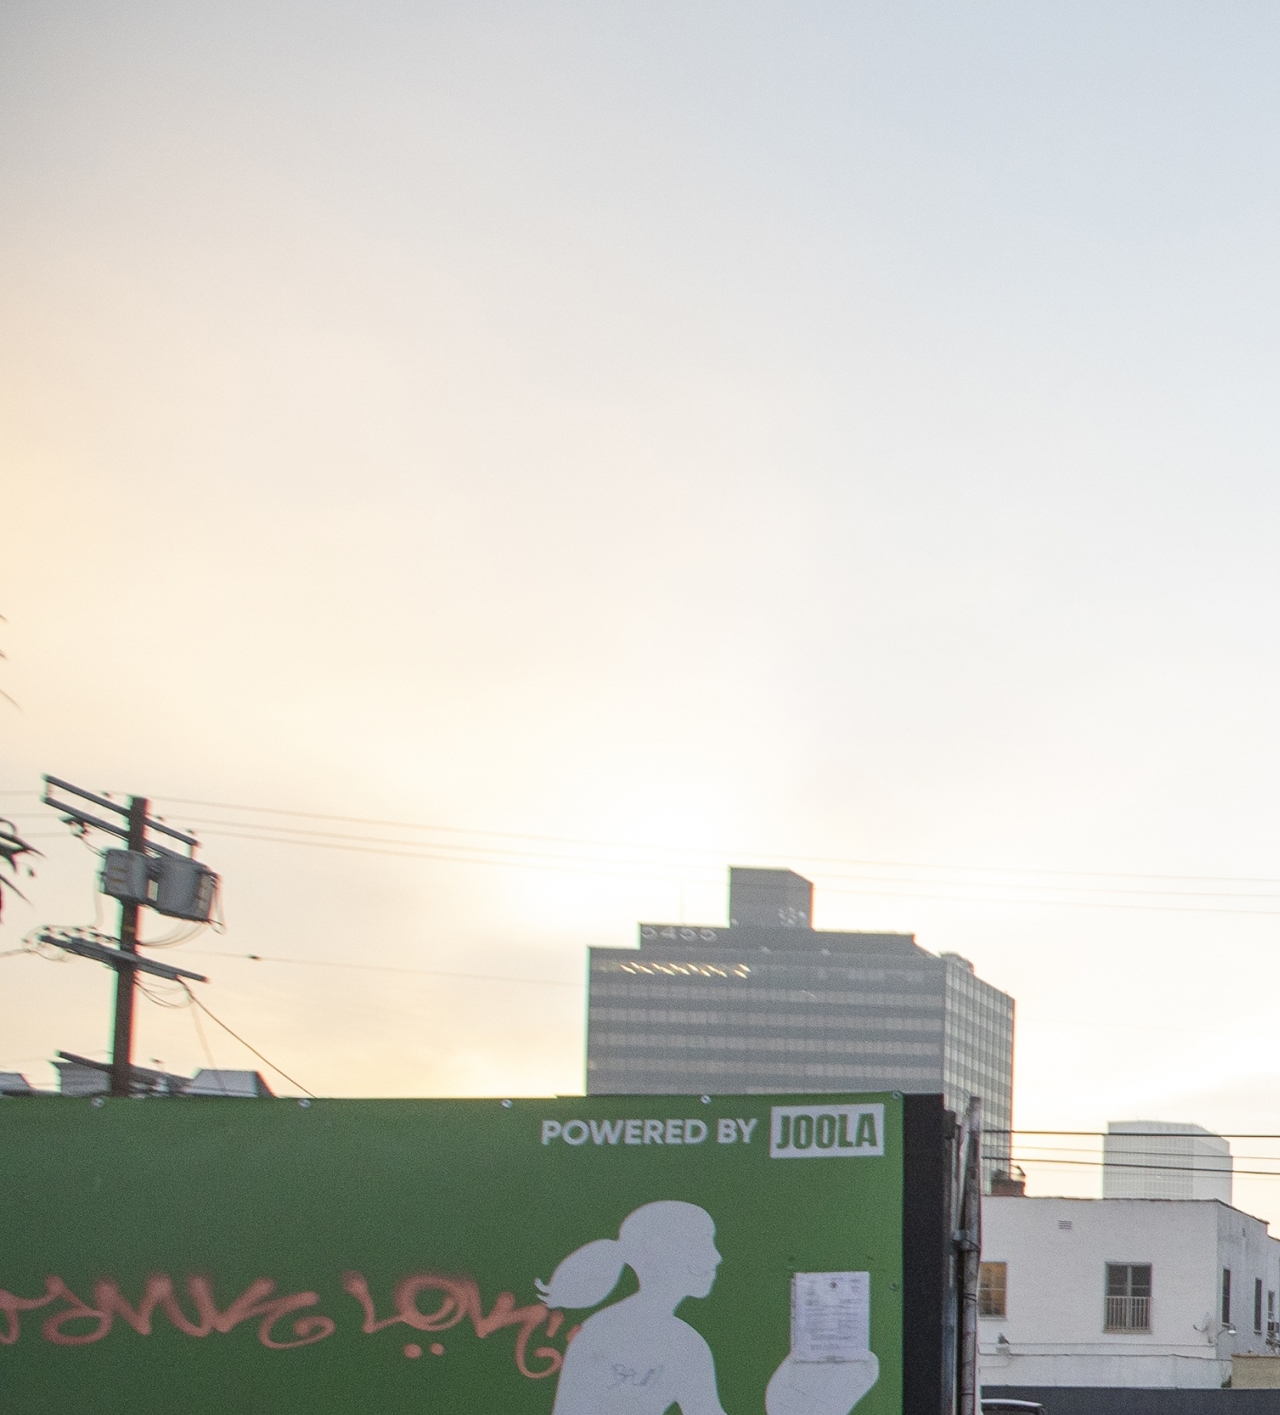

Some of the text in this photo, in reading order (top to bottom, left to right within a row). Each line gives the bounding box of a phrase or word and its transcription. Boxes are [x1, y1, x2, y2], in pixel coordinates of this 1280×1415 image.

[541, 1118, 757, 1146] POWERED BY
[775, 1112, 878, 1150] JOOLA
